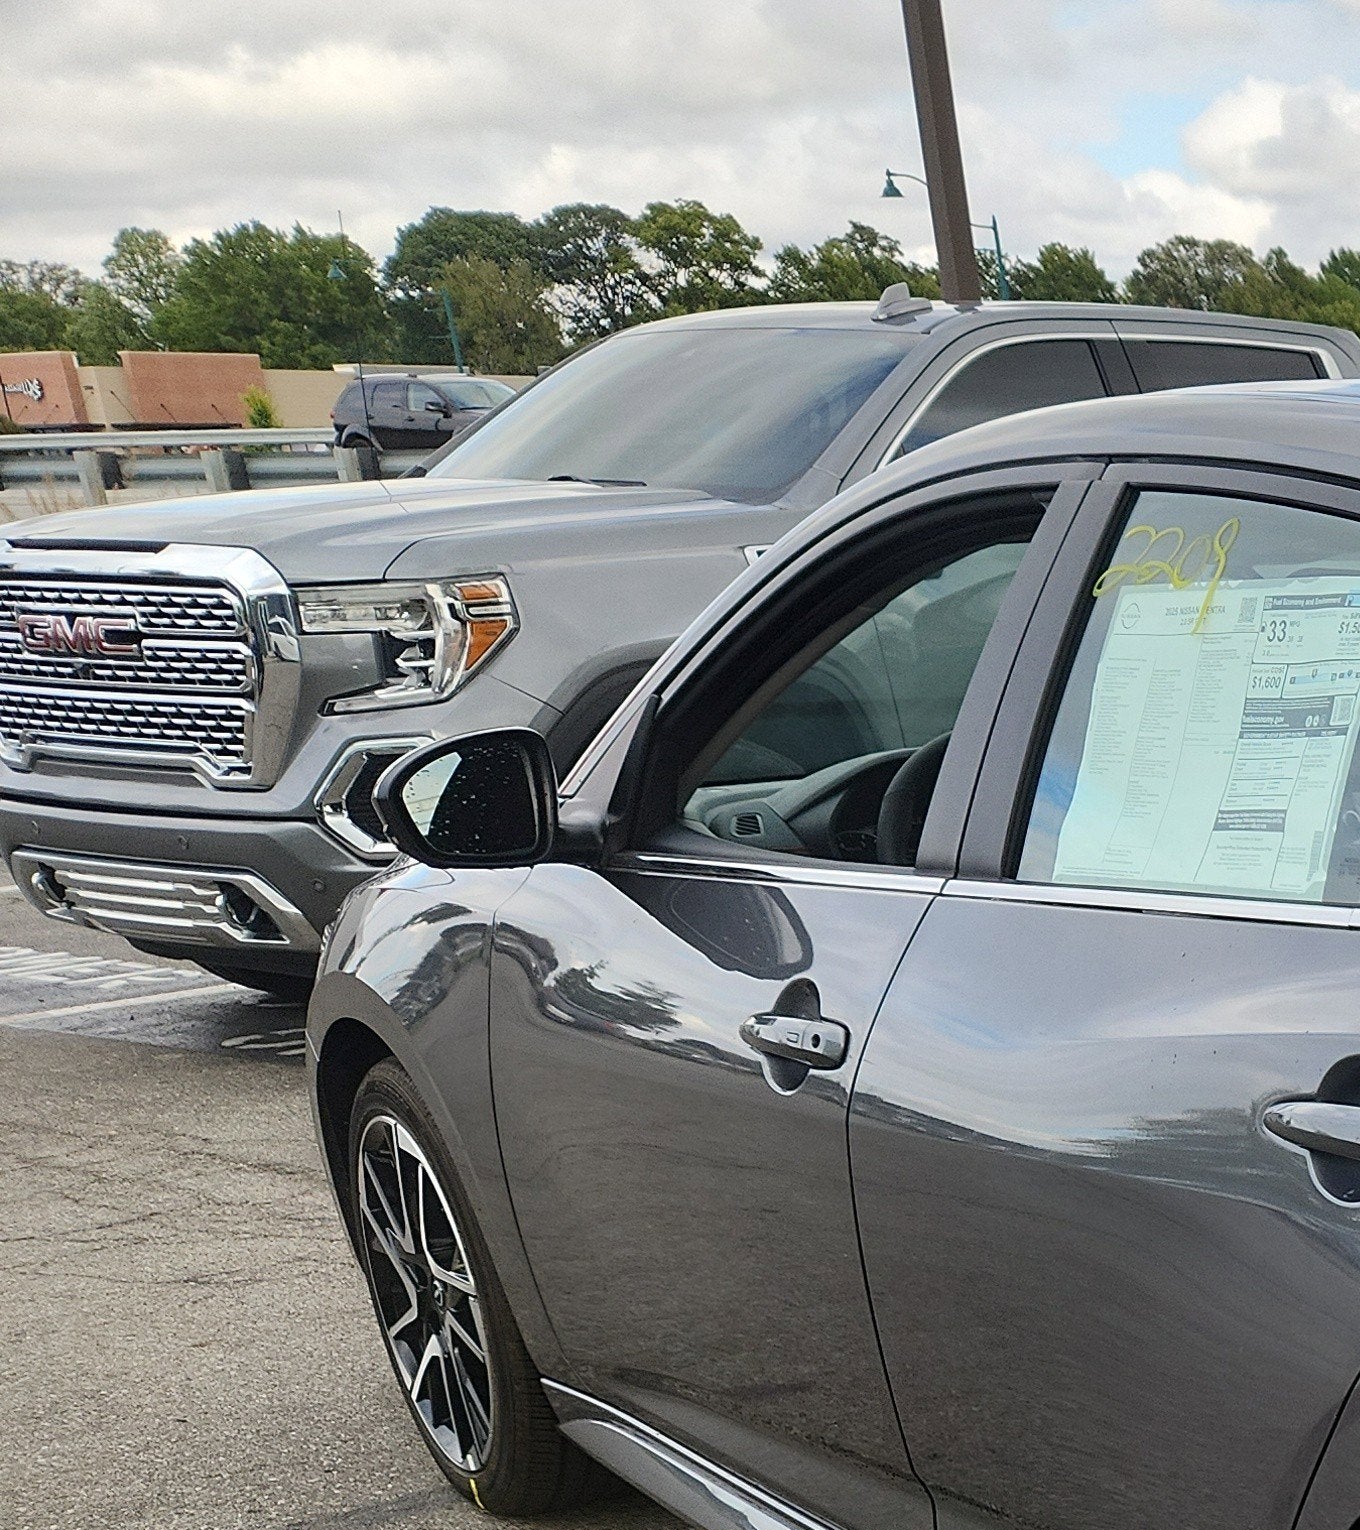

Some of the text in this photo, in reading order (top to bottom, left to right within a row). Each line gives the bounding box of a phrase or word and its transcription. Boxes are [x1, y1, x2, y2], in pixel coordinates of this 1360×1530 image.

[19, 614, 141, 656] GMC
[1267, 620, 1287, 642] 33
[1251, 676, 1282, 690] $1,600
